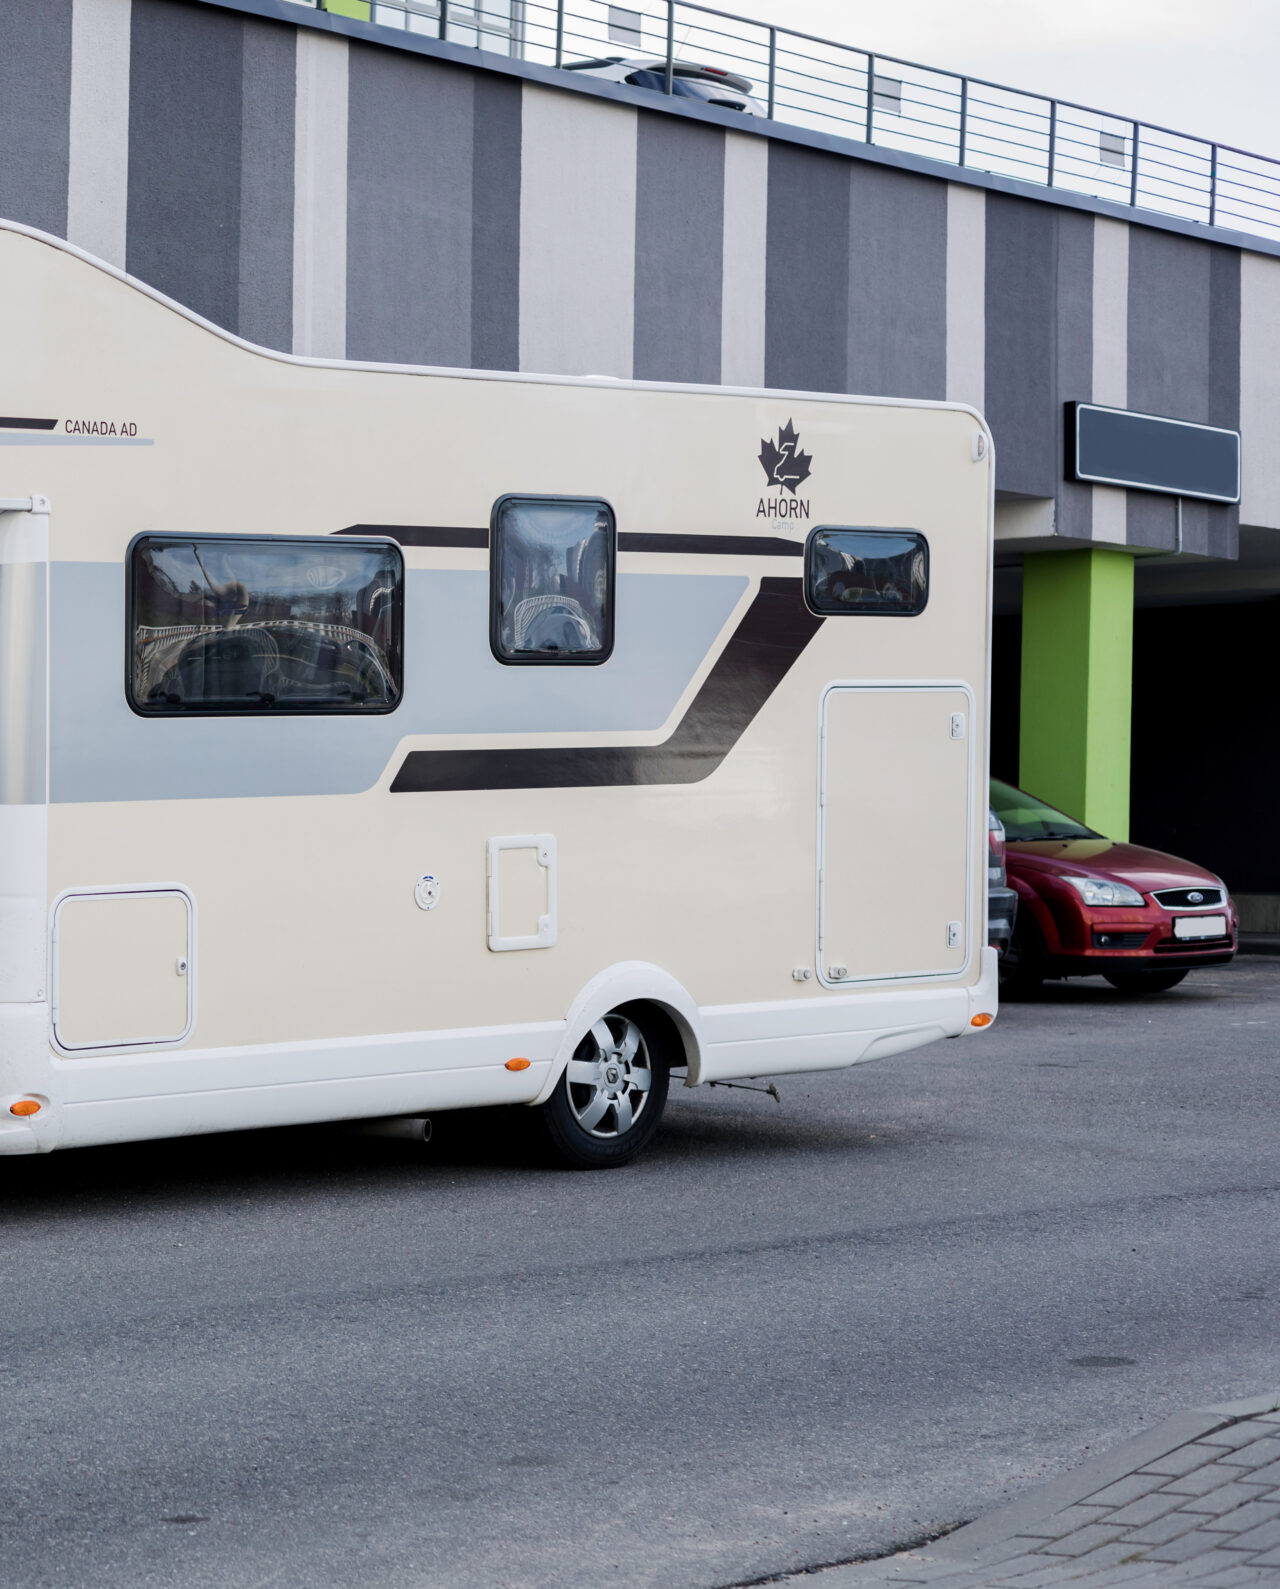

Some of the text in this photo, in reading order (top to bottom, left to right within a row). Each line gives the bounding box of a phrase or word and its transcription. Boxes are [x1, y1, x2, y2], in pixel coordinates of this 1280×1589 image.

[65, 419, 137, 437] CANADA AD
[756, 497, 810, 519] AHORN
[771, 519, 795, 533] Camp
